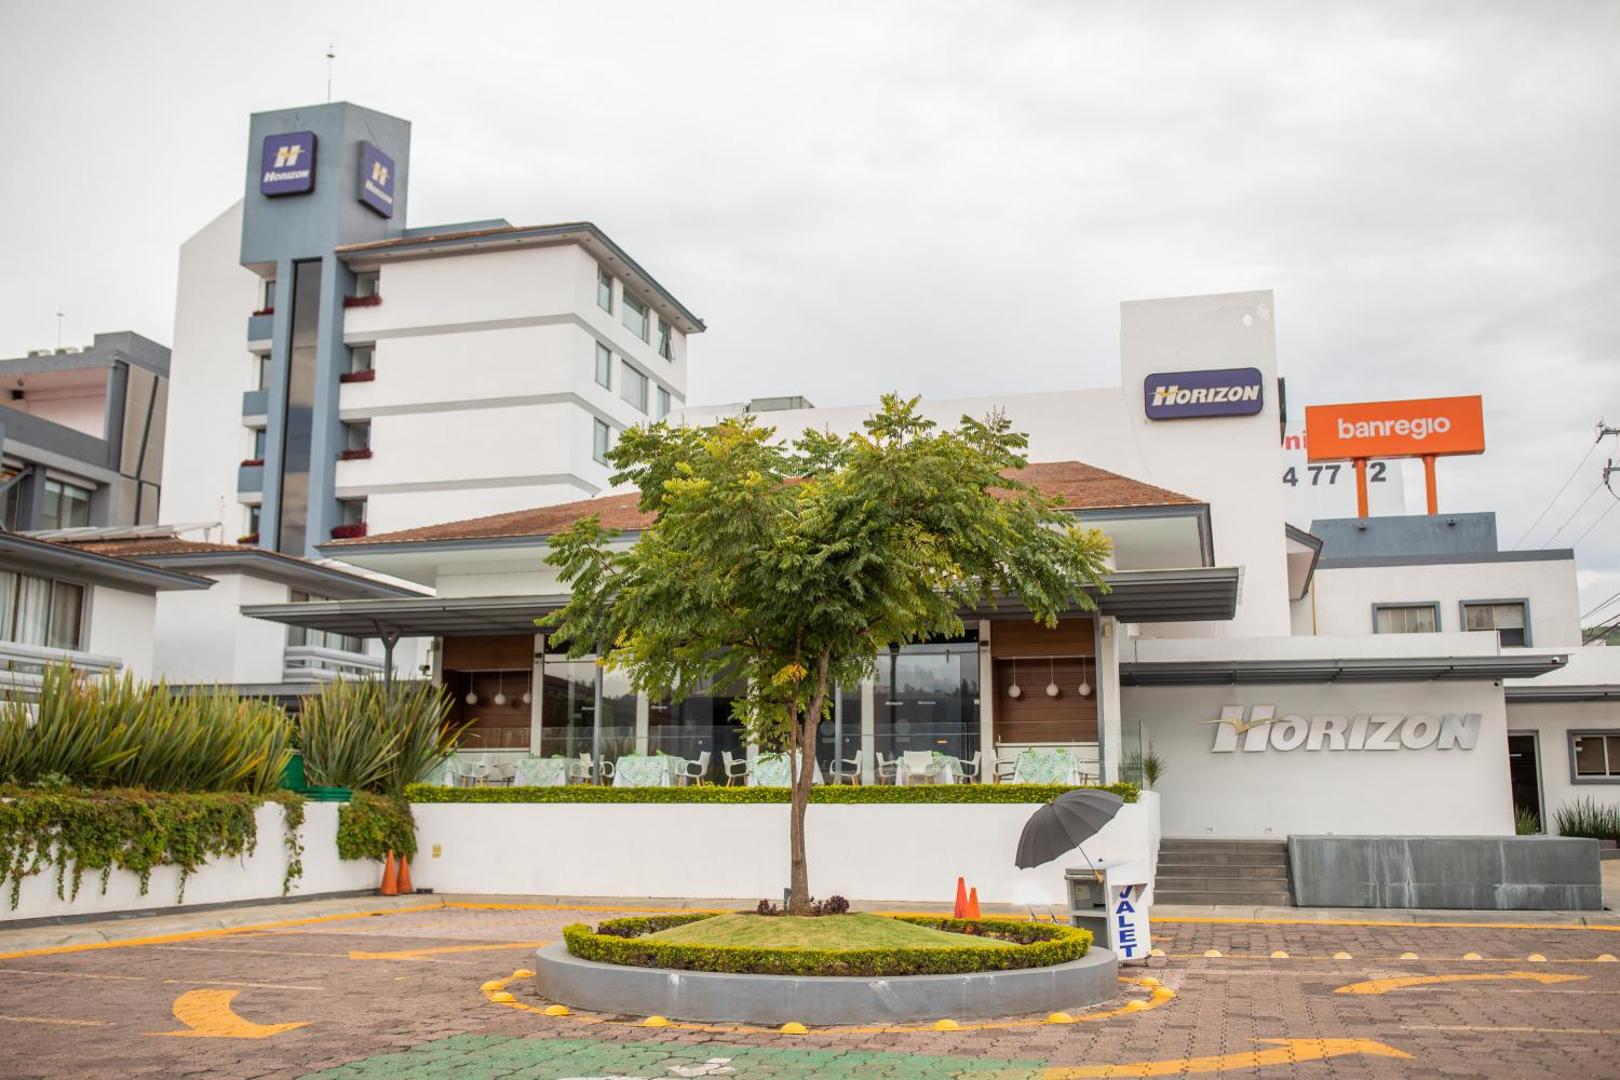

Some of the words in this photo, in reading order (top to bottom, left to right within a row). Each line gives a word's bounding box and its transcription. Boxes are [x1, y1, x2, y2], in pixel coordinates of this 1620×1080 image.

[274, 144, 302, 168] H
[1151, 384, 1260, 407] HORIZON
[1337, 416, 1451, 440] banregio
[1282, 466, 1299, 487] 4
[1307, 464, 1342, 486] 77
[1210, 704, 1484, 753] HORIZON
